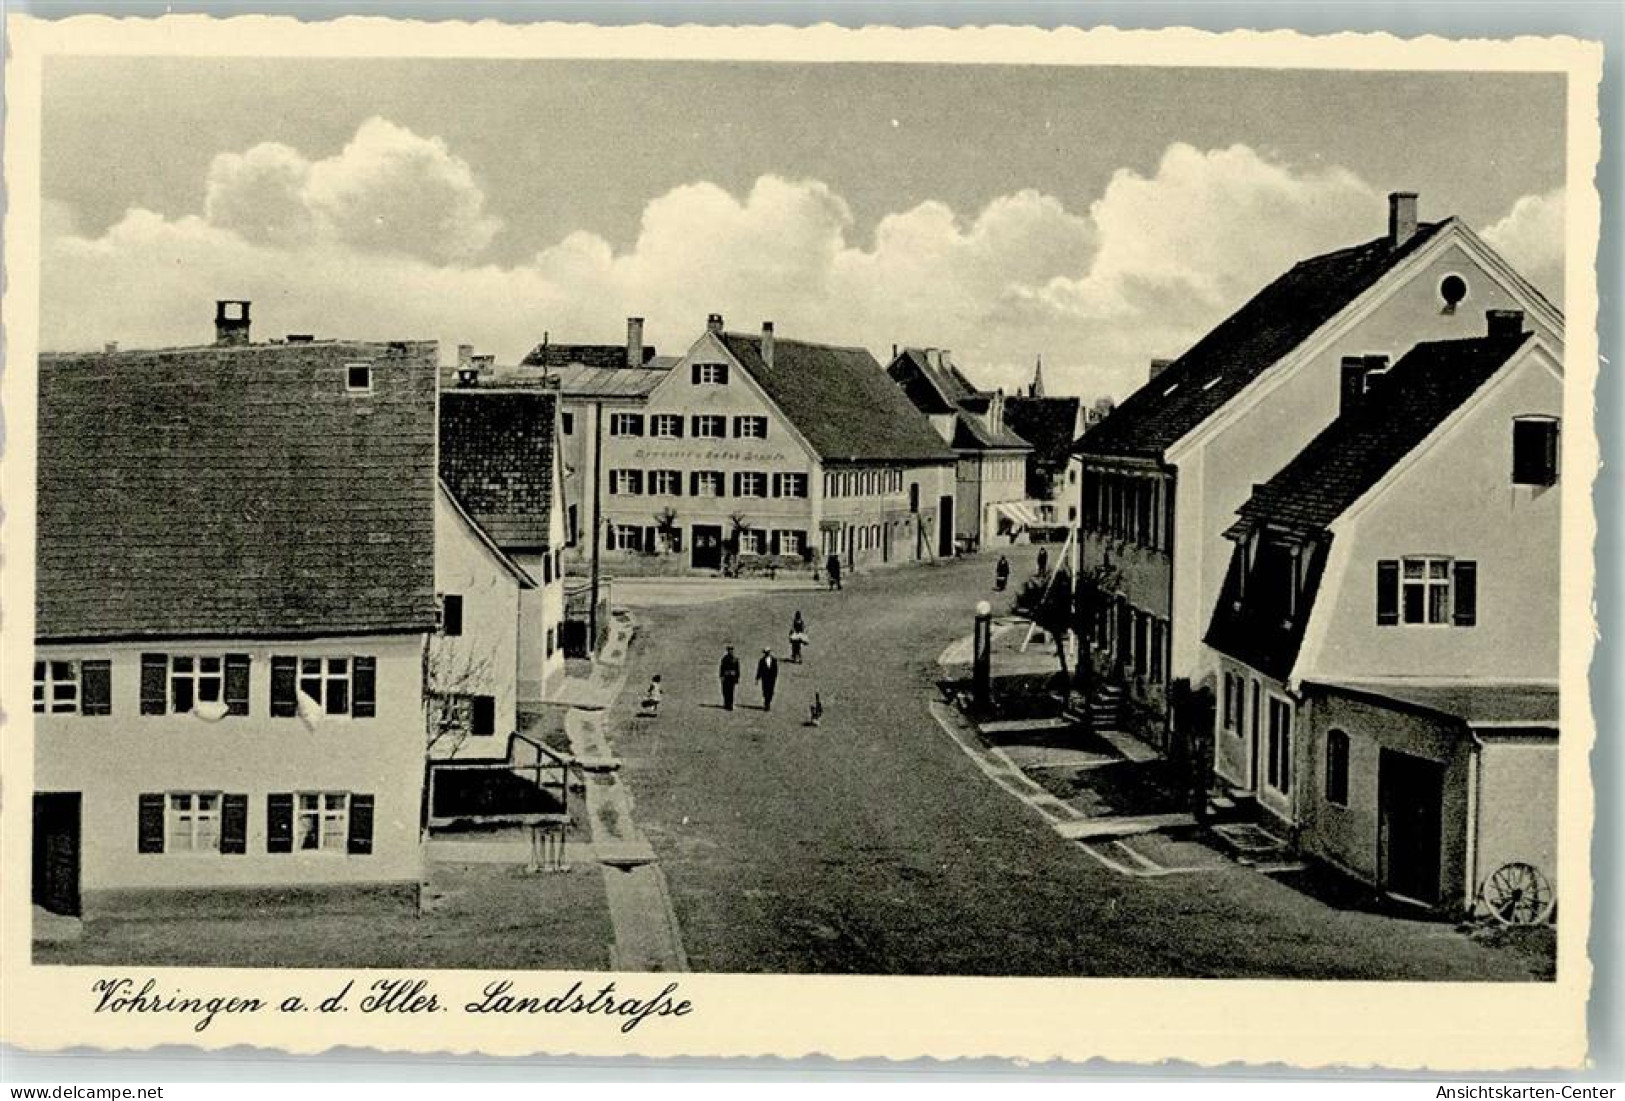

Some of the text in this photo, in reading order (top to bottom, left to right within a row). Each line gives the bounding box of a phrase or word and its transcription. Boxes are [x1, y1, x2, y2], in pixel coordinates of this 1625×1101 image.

[91, 978, 267, 1032] Vöhringen
[280, 996, 309, 1013] a.
[314, 979, 354, 1013] d.
